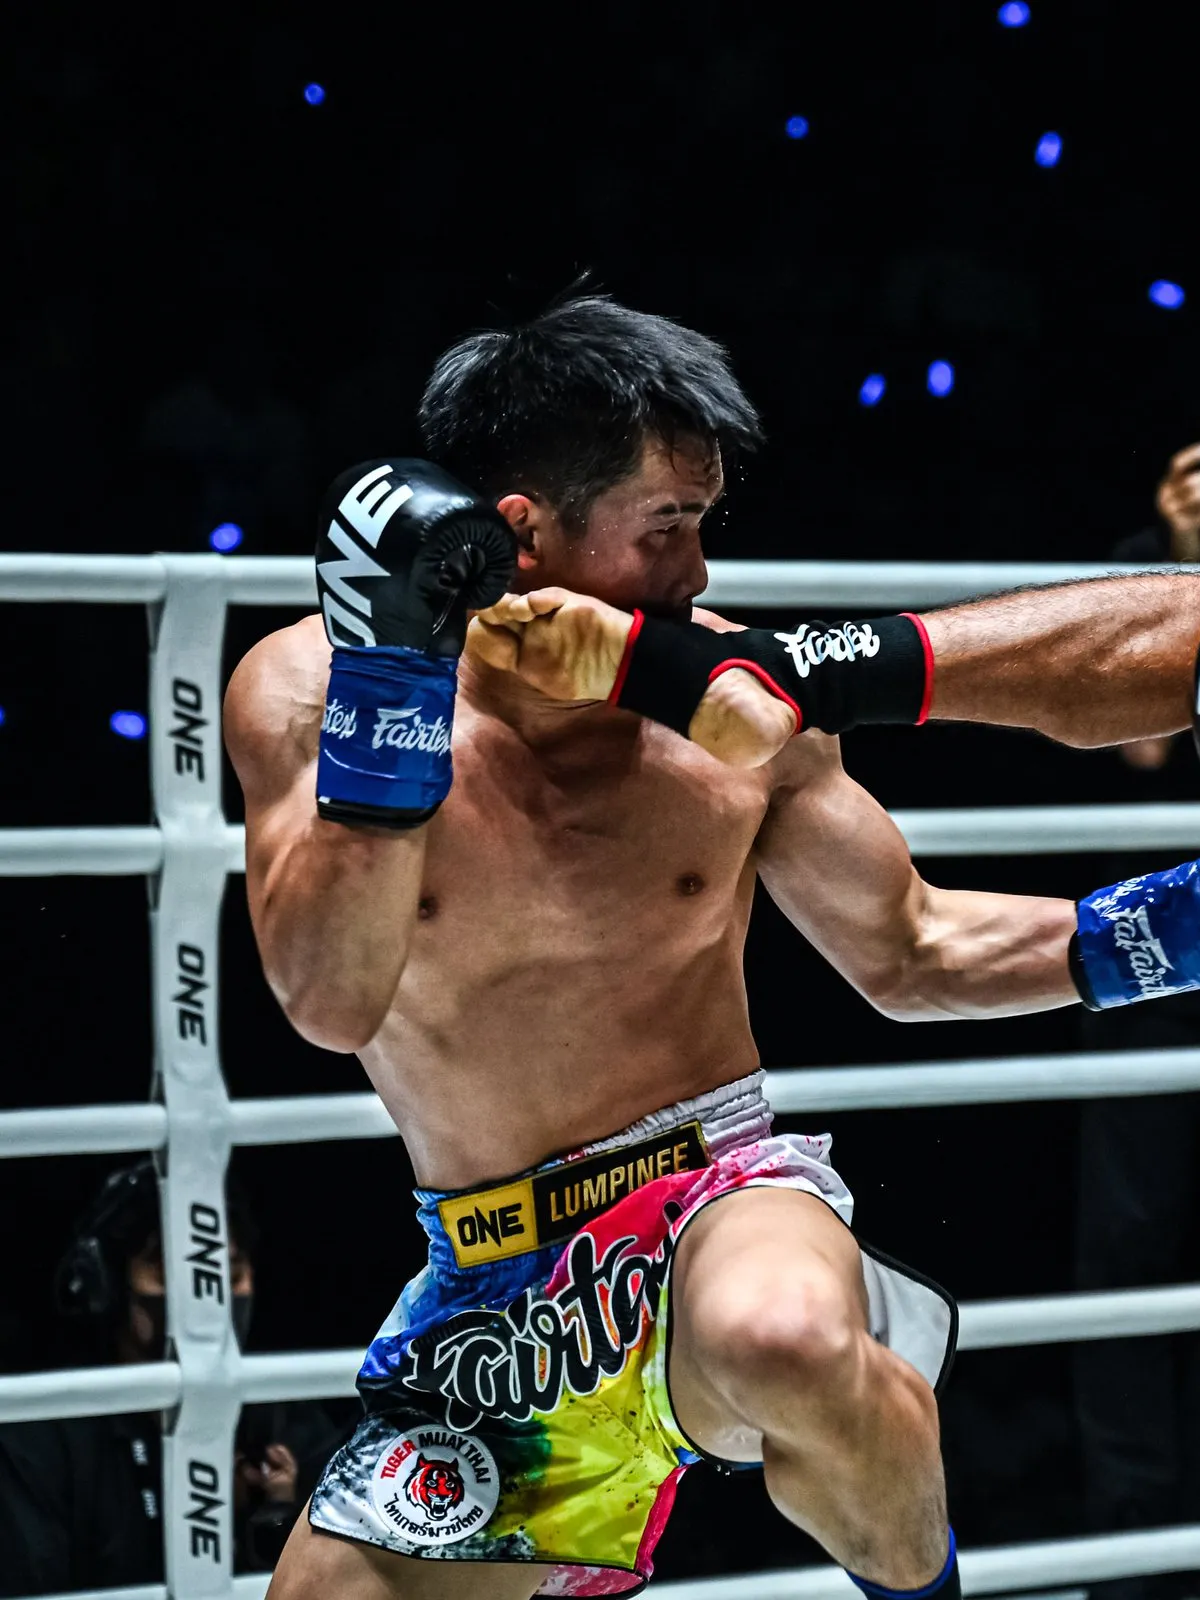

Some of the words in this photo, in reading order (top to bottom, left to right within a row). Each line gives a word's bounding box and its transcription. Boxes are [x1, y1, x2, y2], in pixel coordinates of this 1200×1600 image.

[316, 464, 415, 648] ONE
[166, 677, 210, 783] ONE
[321, 698, 358, 739] tex
[170, 942, 210, 1046] ONE
[456, 1202, 526, 1248] ONE
[549, 1141, 690, 1223] LUMPINEE
[183, 1202, 226, 1305] ONE
[380, 1439, 418, 1479] TIGER
[417, 1431, 470, 1451] MUAY
[463, 1444, 492, 1484] THAI
[183, 1460, 227, 1563] ONE
